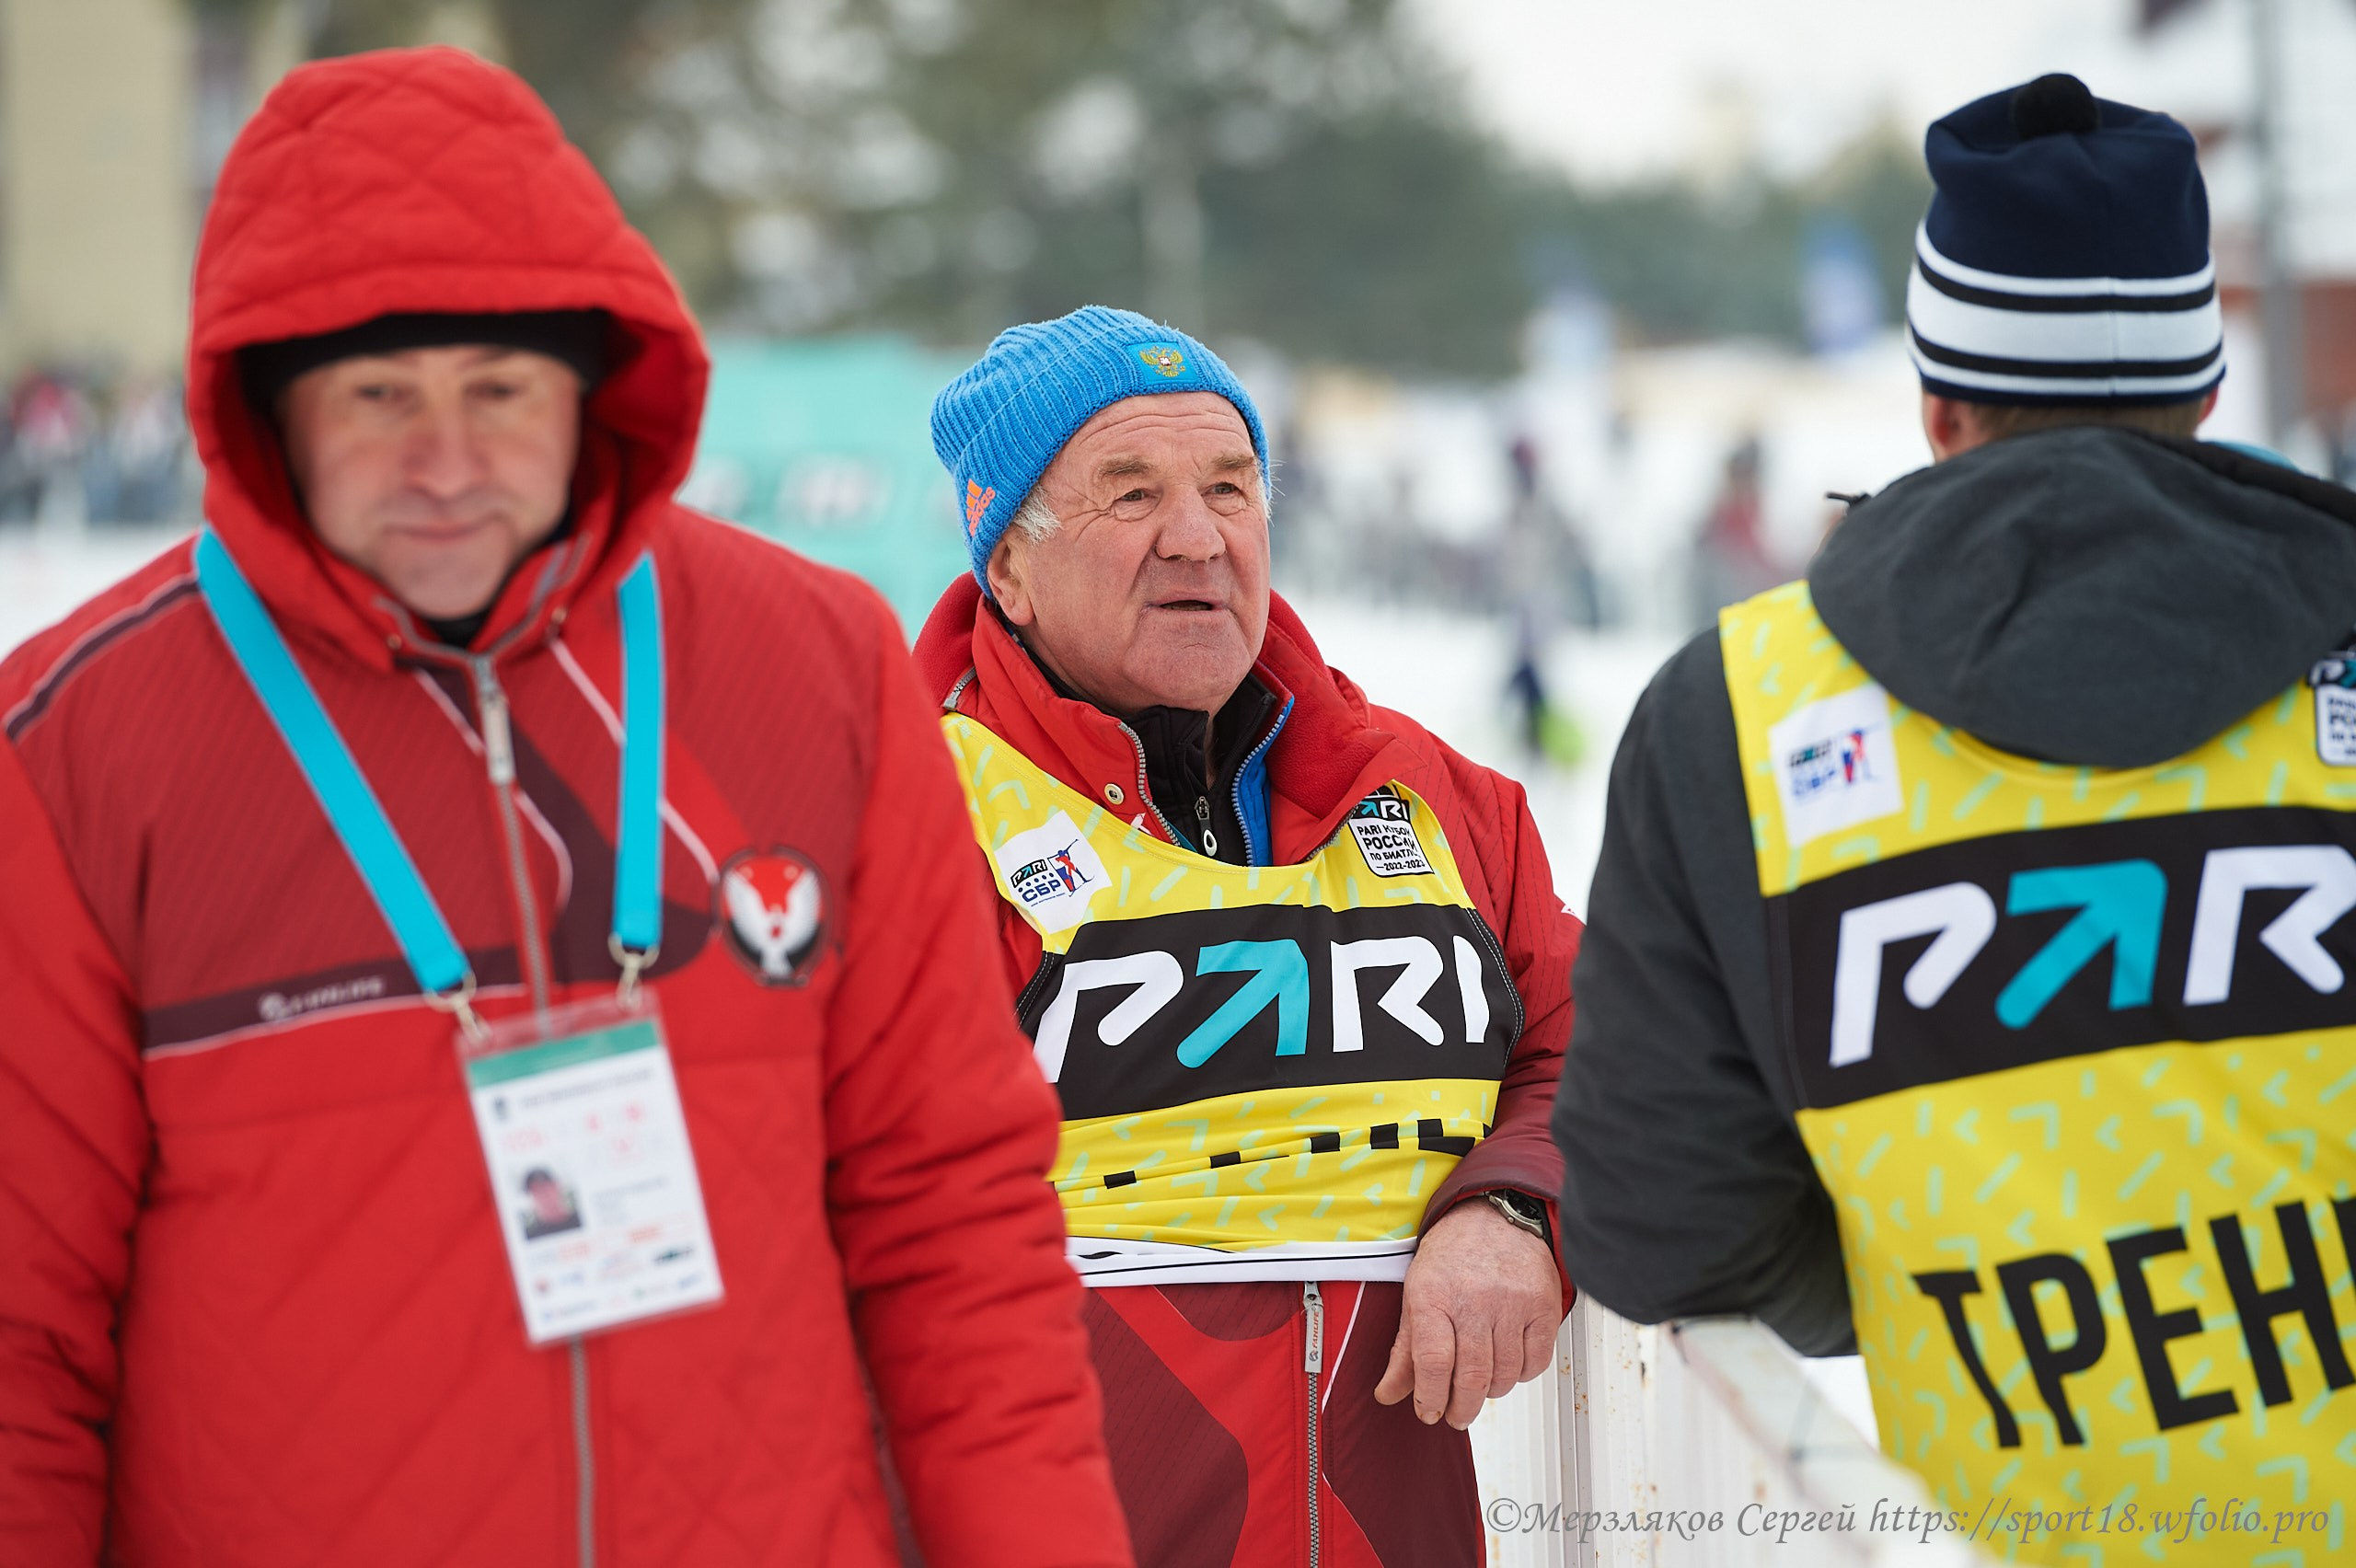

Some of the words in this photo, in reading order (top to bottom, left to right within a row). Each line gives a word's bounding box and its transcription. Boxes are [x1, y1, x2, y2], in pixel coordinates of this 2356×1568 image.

[1359, 800, 1409, 820] ARI
[1357, 824, 1382, 836] PARI
[1369, 852, 1382, 861] ПО
[1012, 860, 1046, 885] PARI
[1022, 879, 1061, 903] СБР
[1033, 935, 1490, 1083] PARI
[1311, 1311, 1320, 1349] FANLIFE
